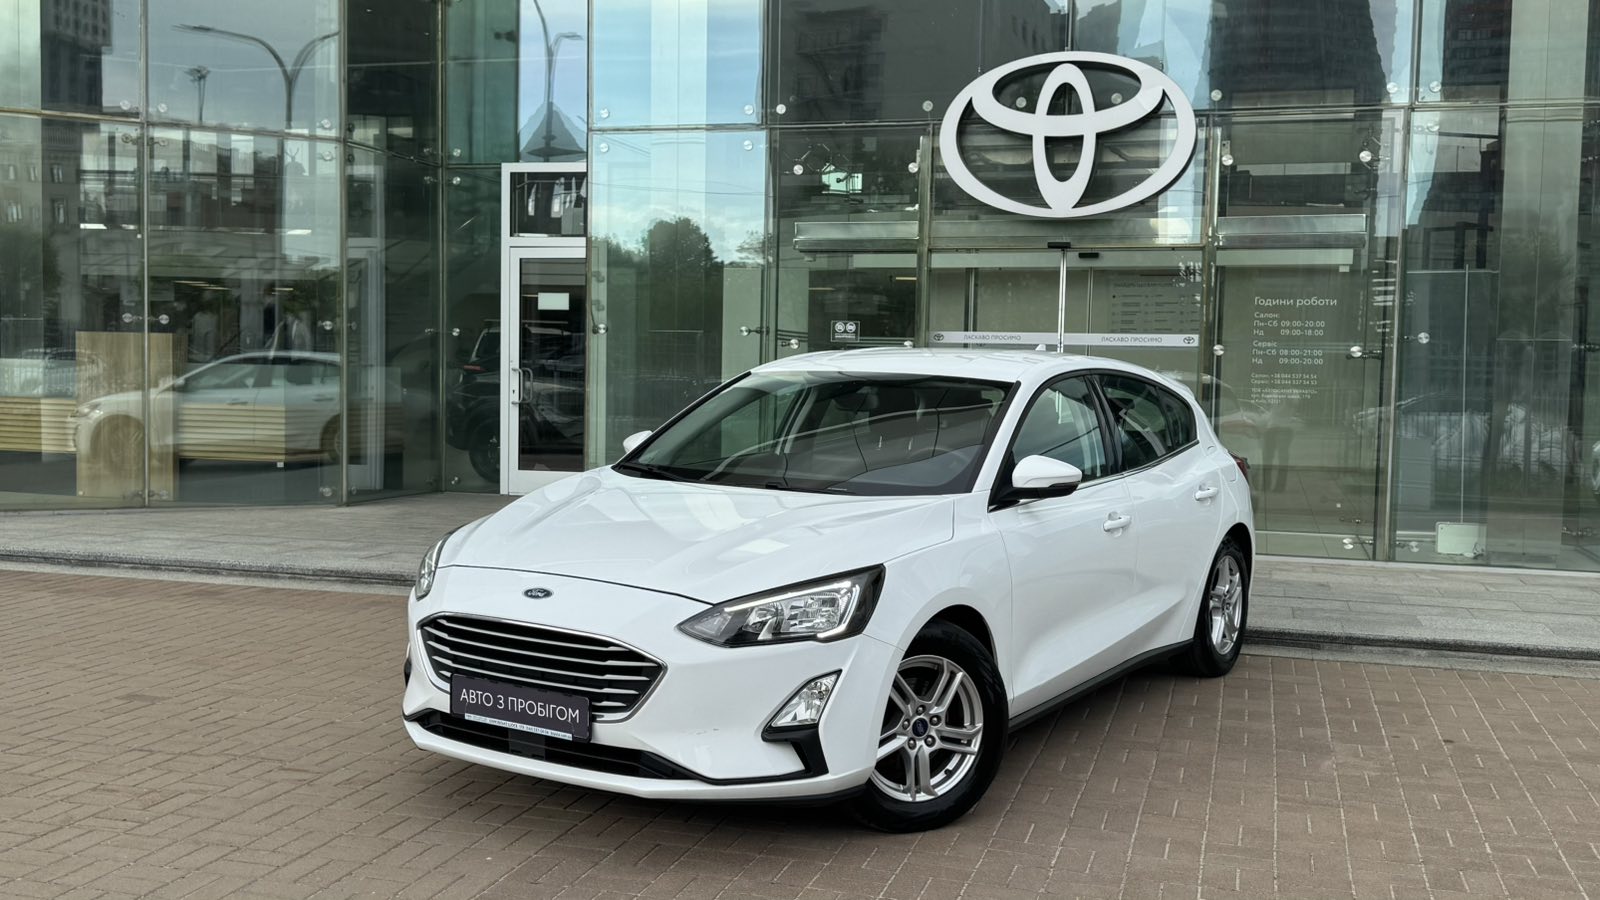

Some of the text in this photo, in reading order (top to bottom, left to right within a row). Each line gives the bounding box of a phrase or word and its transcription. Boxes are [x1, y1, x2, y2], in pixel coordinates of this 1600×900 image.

[1254, 296, 1337, 308] Години роботи
[1252, 357, 1323, 365] Нд 09:00-20:00
[460, 688, 493, 707] АВТО
[508, 697, 580, 723] ПРОБІГОМ
